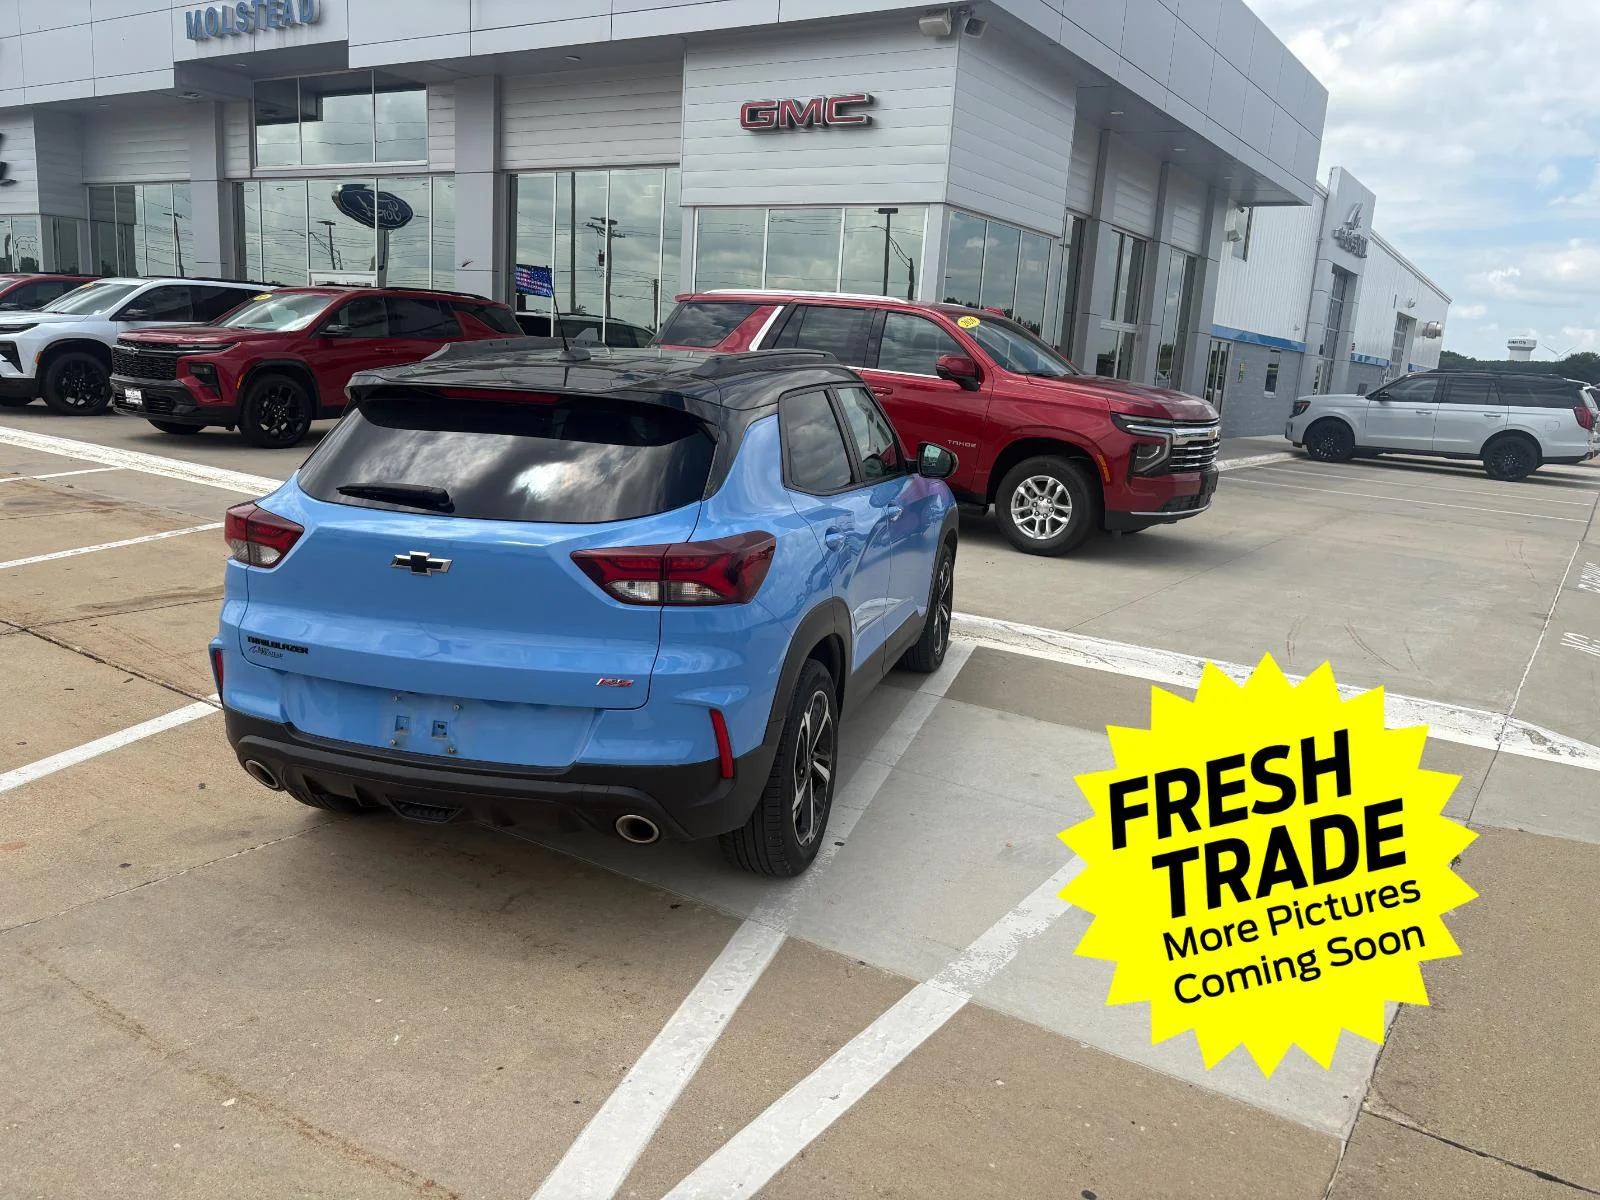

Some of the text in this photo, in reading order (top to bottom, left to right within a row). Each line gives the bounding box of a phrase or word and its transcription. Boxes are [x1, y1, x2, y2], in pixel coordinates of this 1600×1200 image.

[185, 0, 319, 41] MOLSTEAD
[740, 94, 872, 129] GMC
[947, 439, 977, 448] TAHOE
[595, 678, 634, 688] RS
